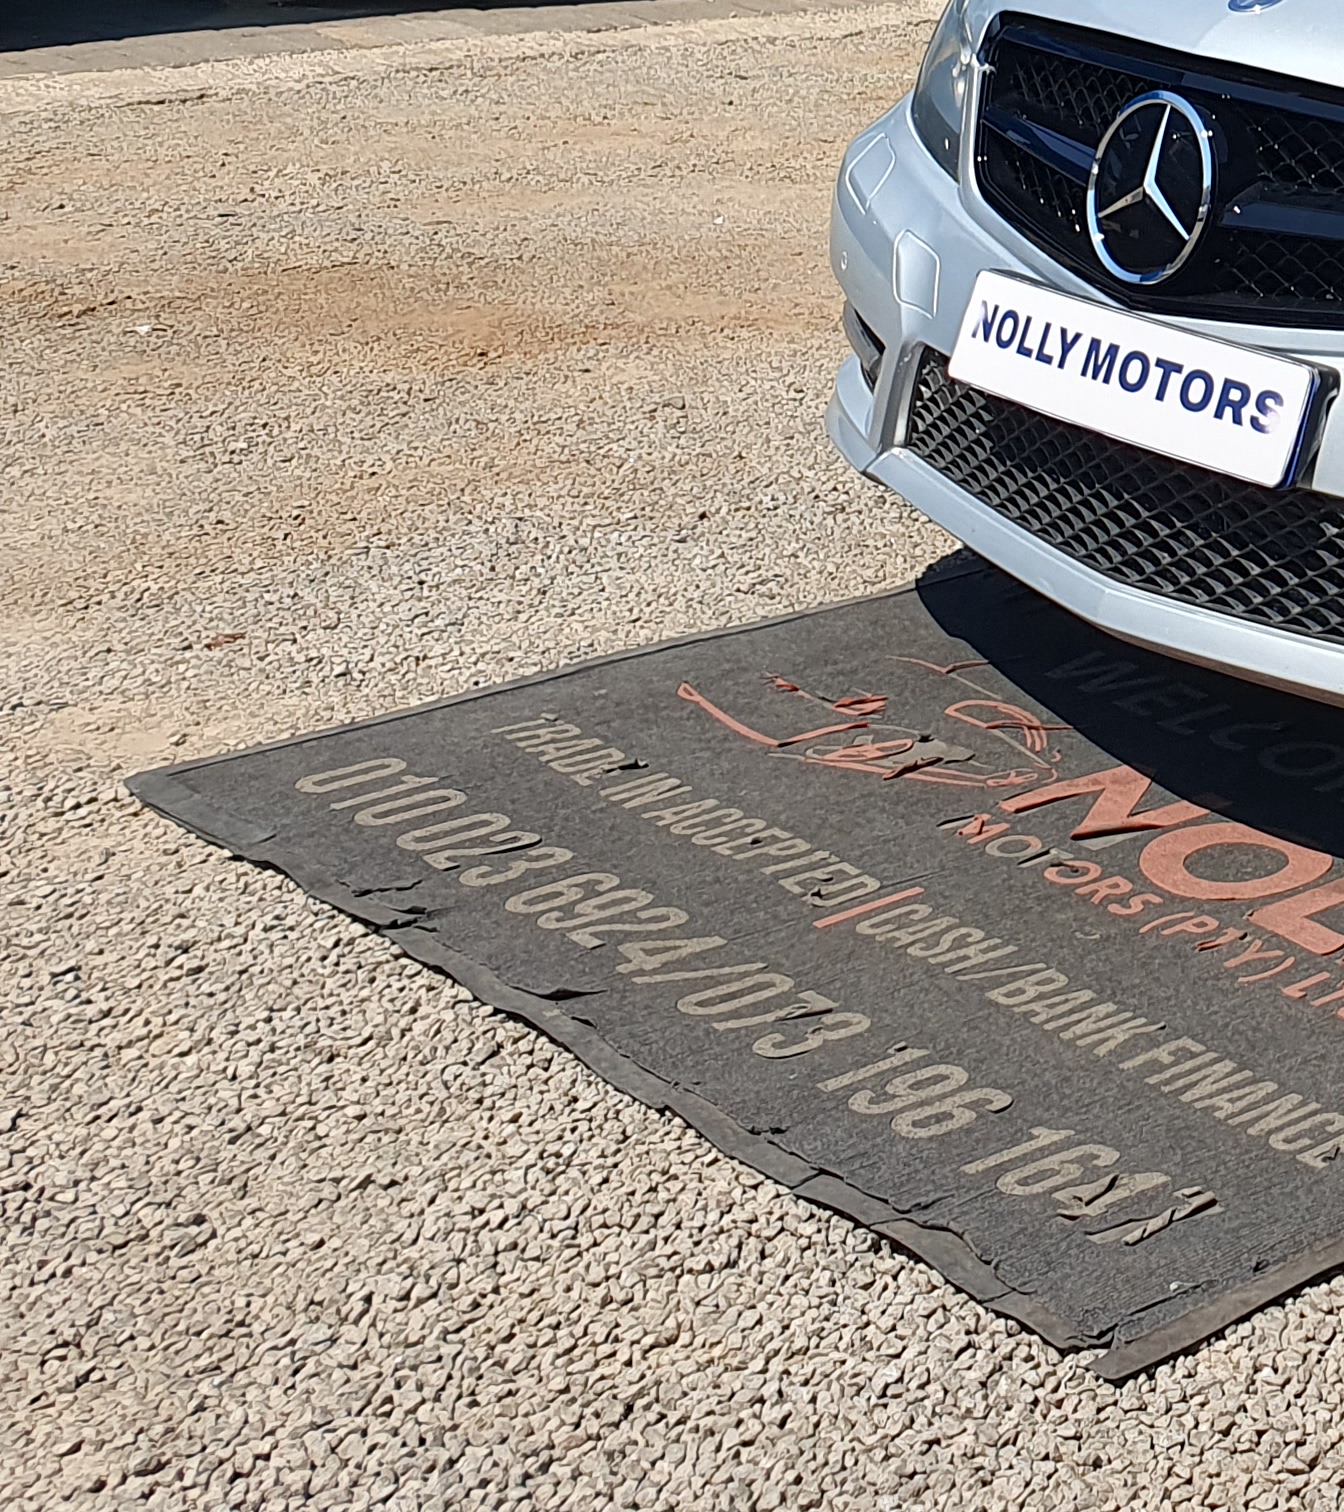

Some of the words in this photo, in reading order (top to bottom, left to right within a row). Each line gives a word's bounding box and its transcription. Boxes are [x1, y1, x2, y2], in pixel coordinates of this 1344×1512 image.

[971, 300, 1084, 371] NOLLY
[1080, 336, 1285, 435] MOTORS
[491, 713, 645, 787] TRADE
[600, 772, 693, 809] IN
[294, 756, 467, 827] 010
[396, 812, 574, 887] 023
[816, 1042, 1014, 1139] 196
[940, 812, 1164, 916] MOTORS
[1139, 910, 1296, 984] (PTY)
